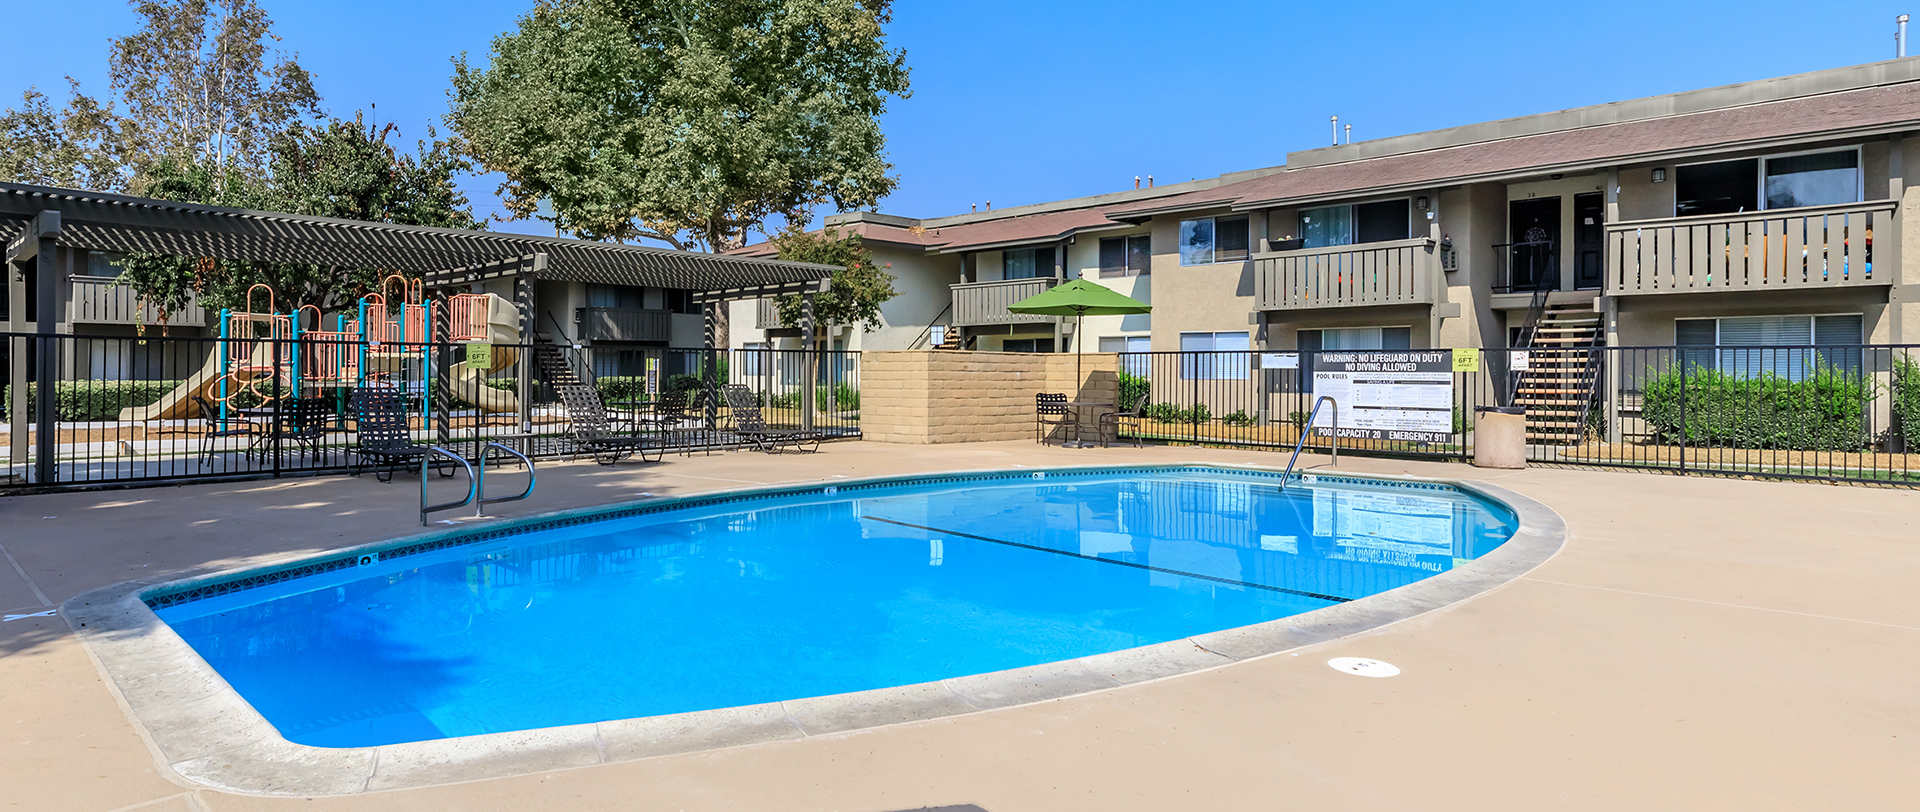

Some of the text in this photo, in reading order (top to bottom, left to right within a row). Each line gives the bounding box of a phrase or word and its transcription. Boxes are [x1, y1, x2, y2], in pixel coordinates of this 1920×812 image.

[1322, 353, 1443, 363] WARNING: NO LIFEGUARD ON DUTY
[1345, 362, 1417, 372] NO DIVING ALLOWED
[1319, 428, 1446, 443] POO CAPACITY 20 EMERGENCY 911
